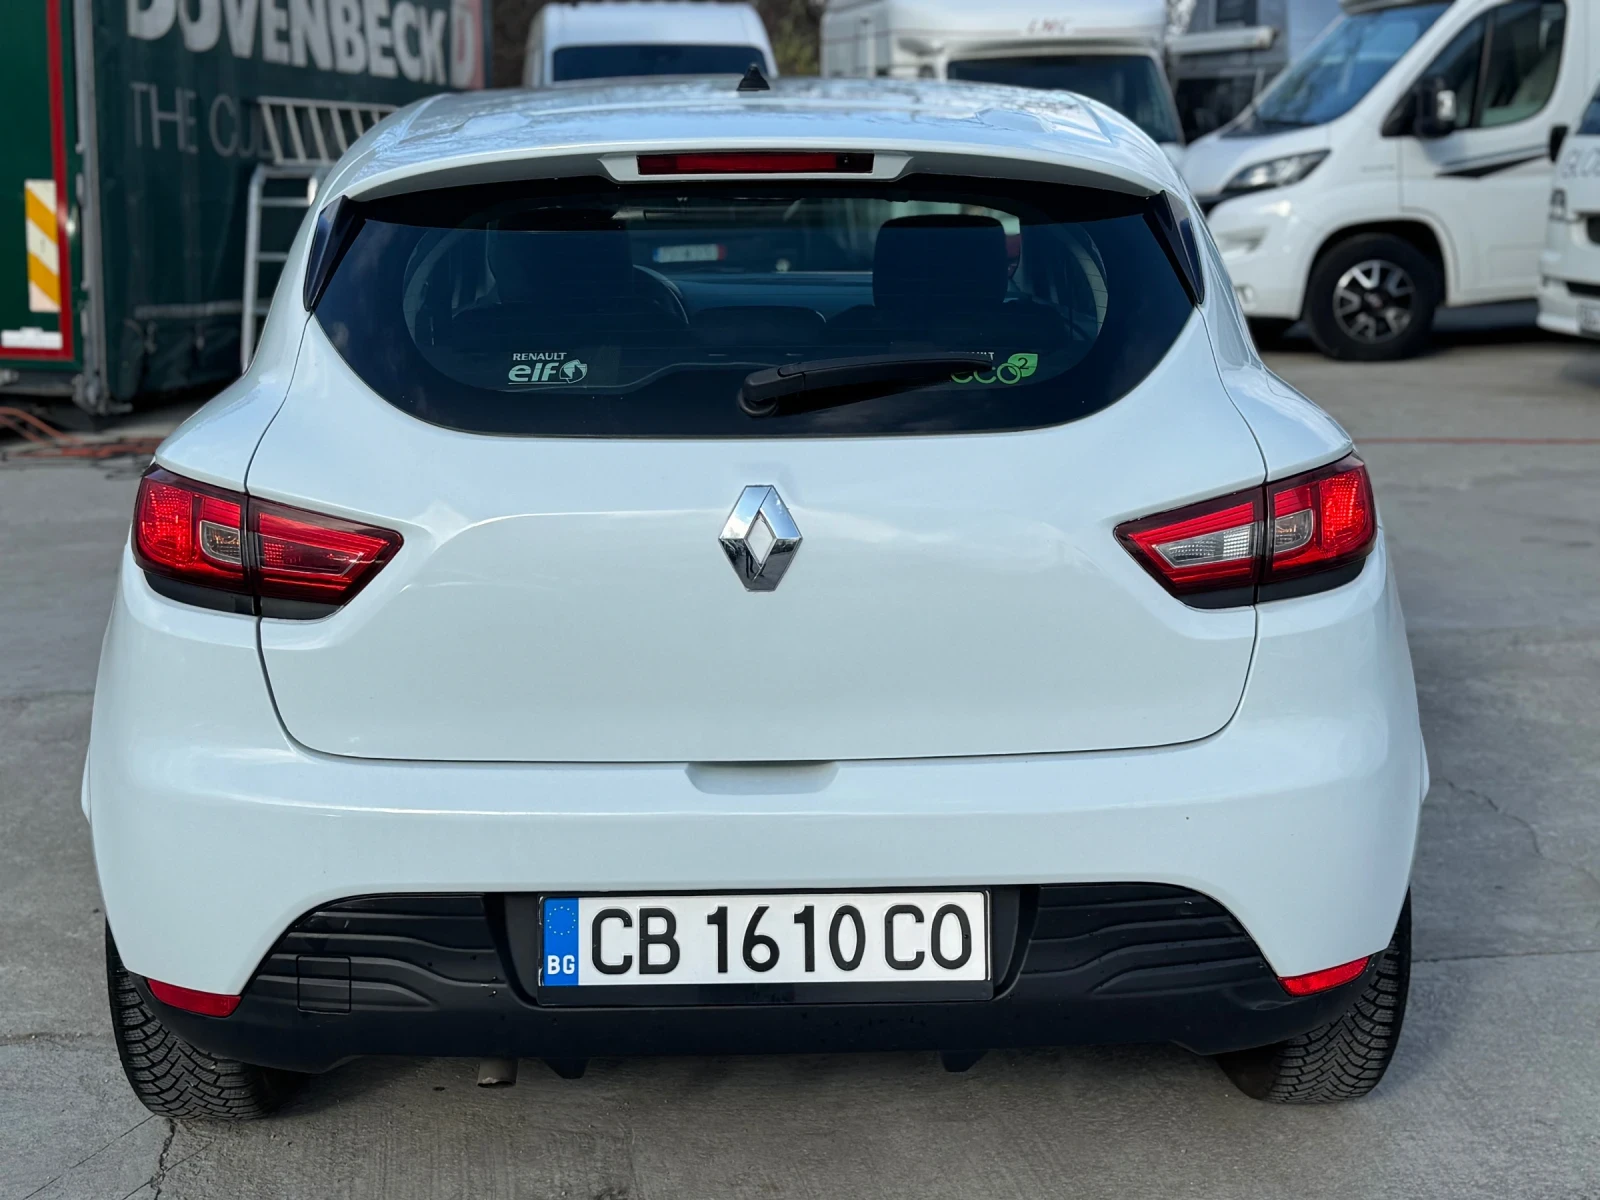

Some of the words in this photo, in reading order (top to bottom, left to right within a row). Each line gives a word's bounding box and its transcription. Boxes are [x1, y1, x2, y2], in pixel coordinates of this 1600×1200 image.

[128, 80, 199, 155] THE
[512, 352, 567, 361] RENAULT
[508, 362, 560, 382] elf
[591, 907, 681, 975] CB
[706, 904, 867, 973] 1610
[884, 904, 972, 971] CO
[547, 955, 576, 975] BG
